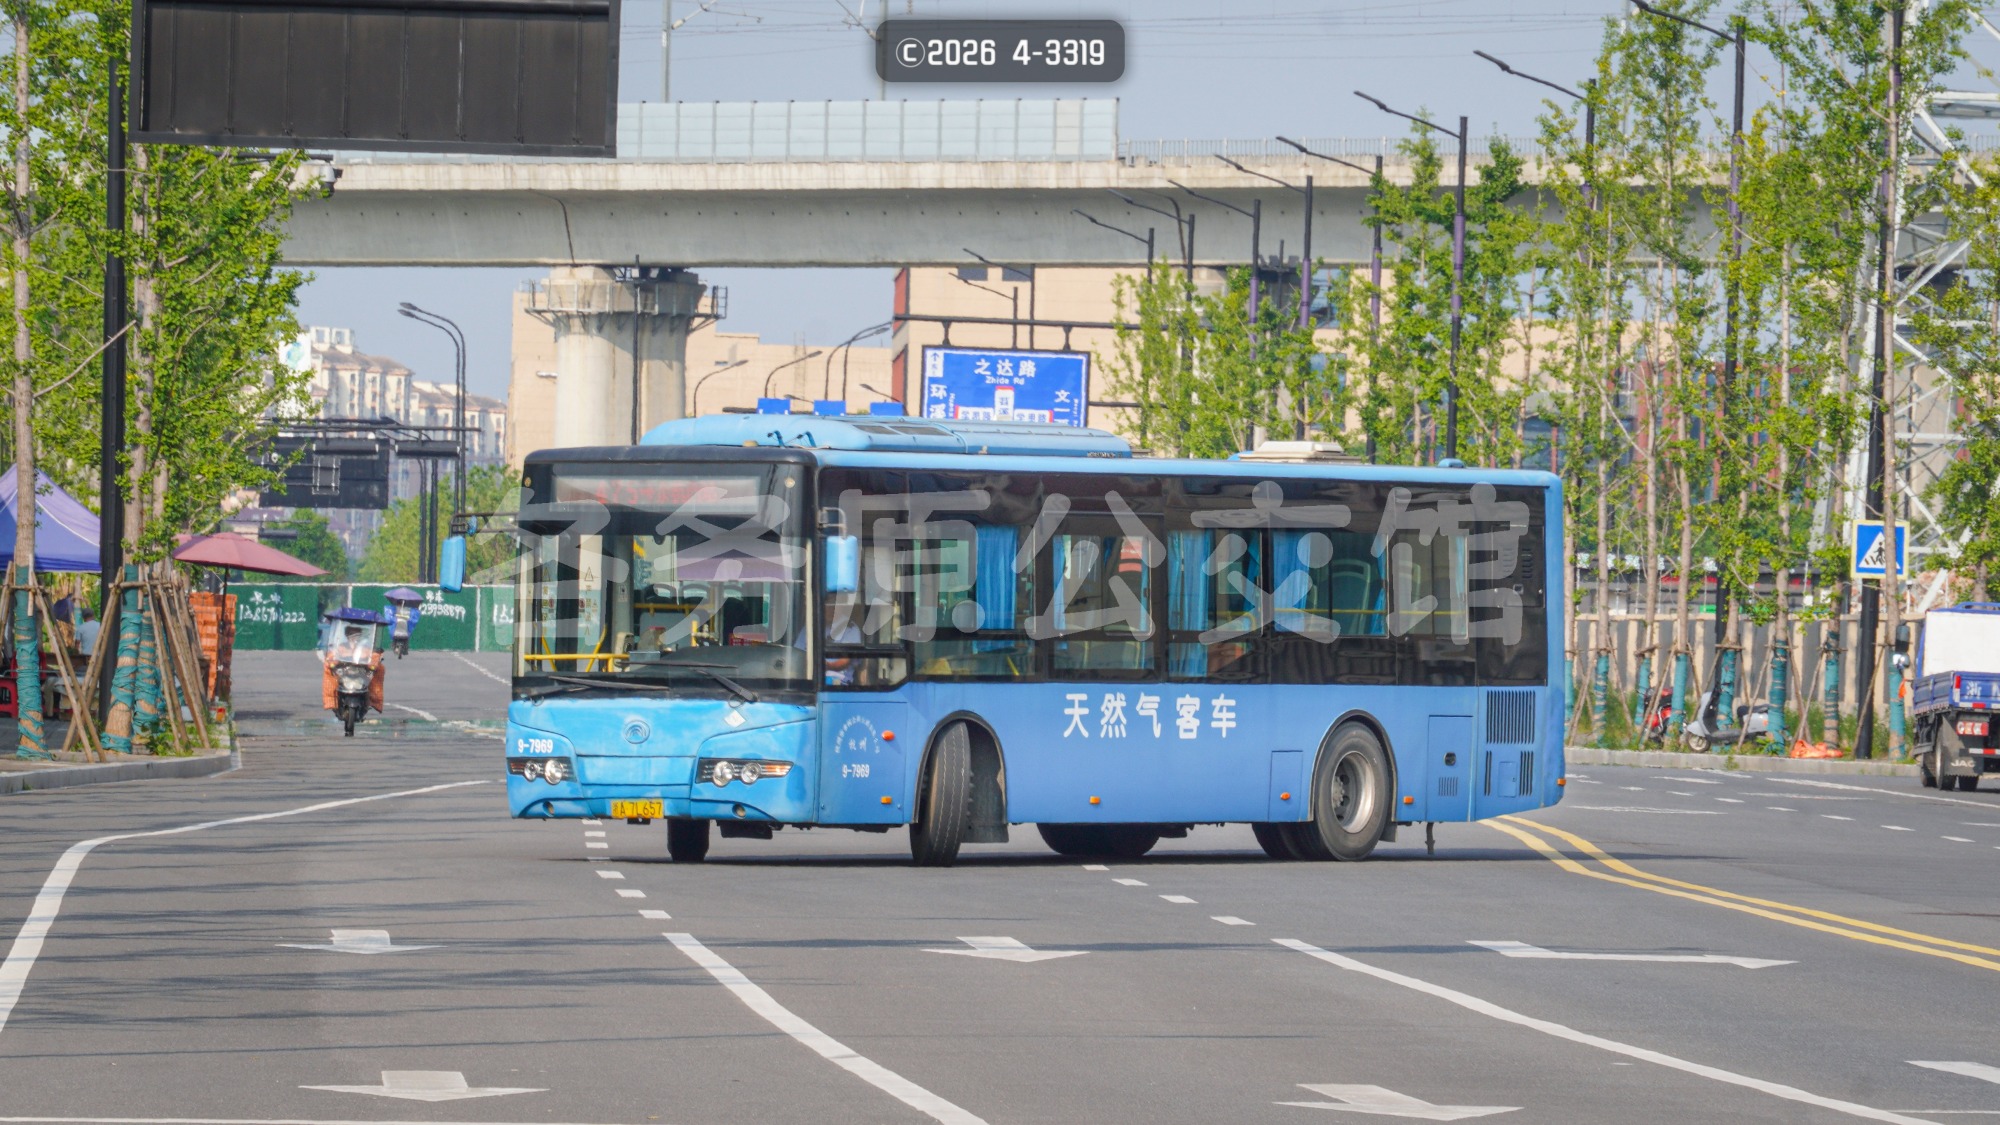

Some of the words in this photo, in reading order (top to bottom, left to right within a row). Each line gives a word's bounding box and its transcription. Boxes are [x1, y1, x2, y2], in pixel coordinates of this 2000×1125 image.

[974, 358, 1037, 378] 之达路
[985, 375, 1010, 385] Zhida
[1063, 692, 1237, 739] 天然气客车
[518, 739, 553, 754] 9-7969
[842, 763, 870, 778] 9-7969
[1950, 759, 1976, 768] JAC
